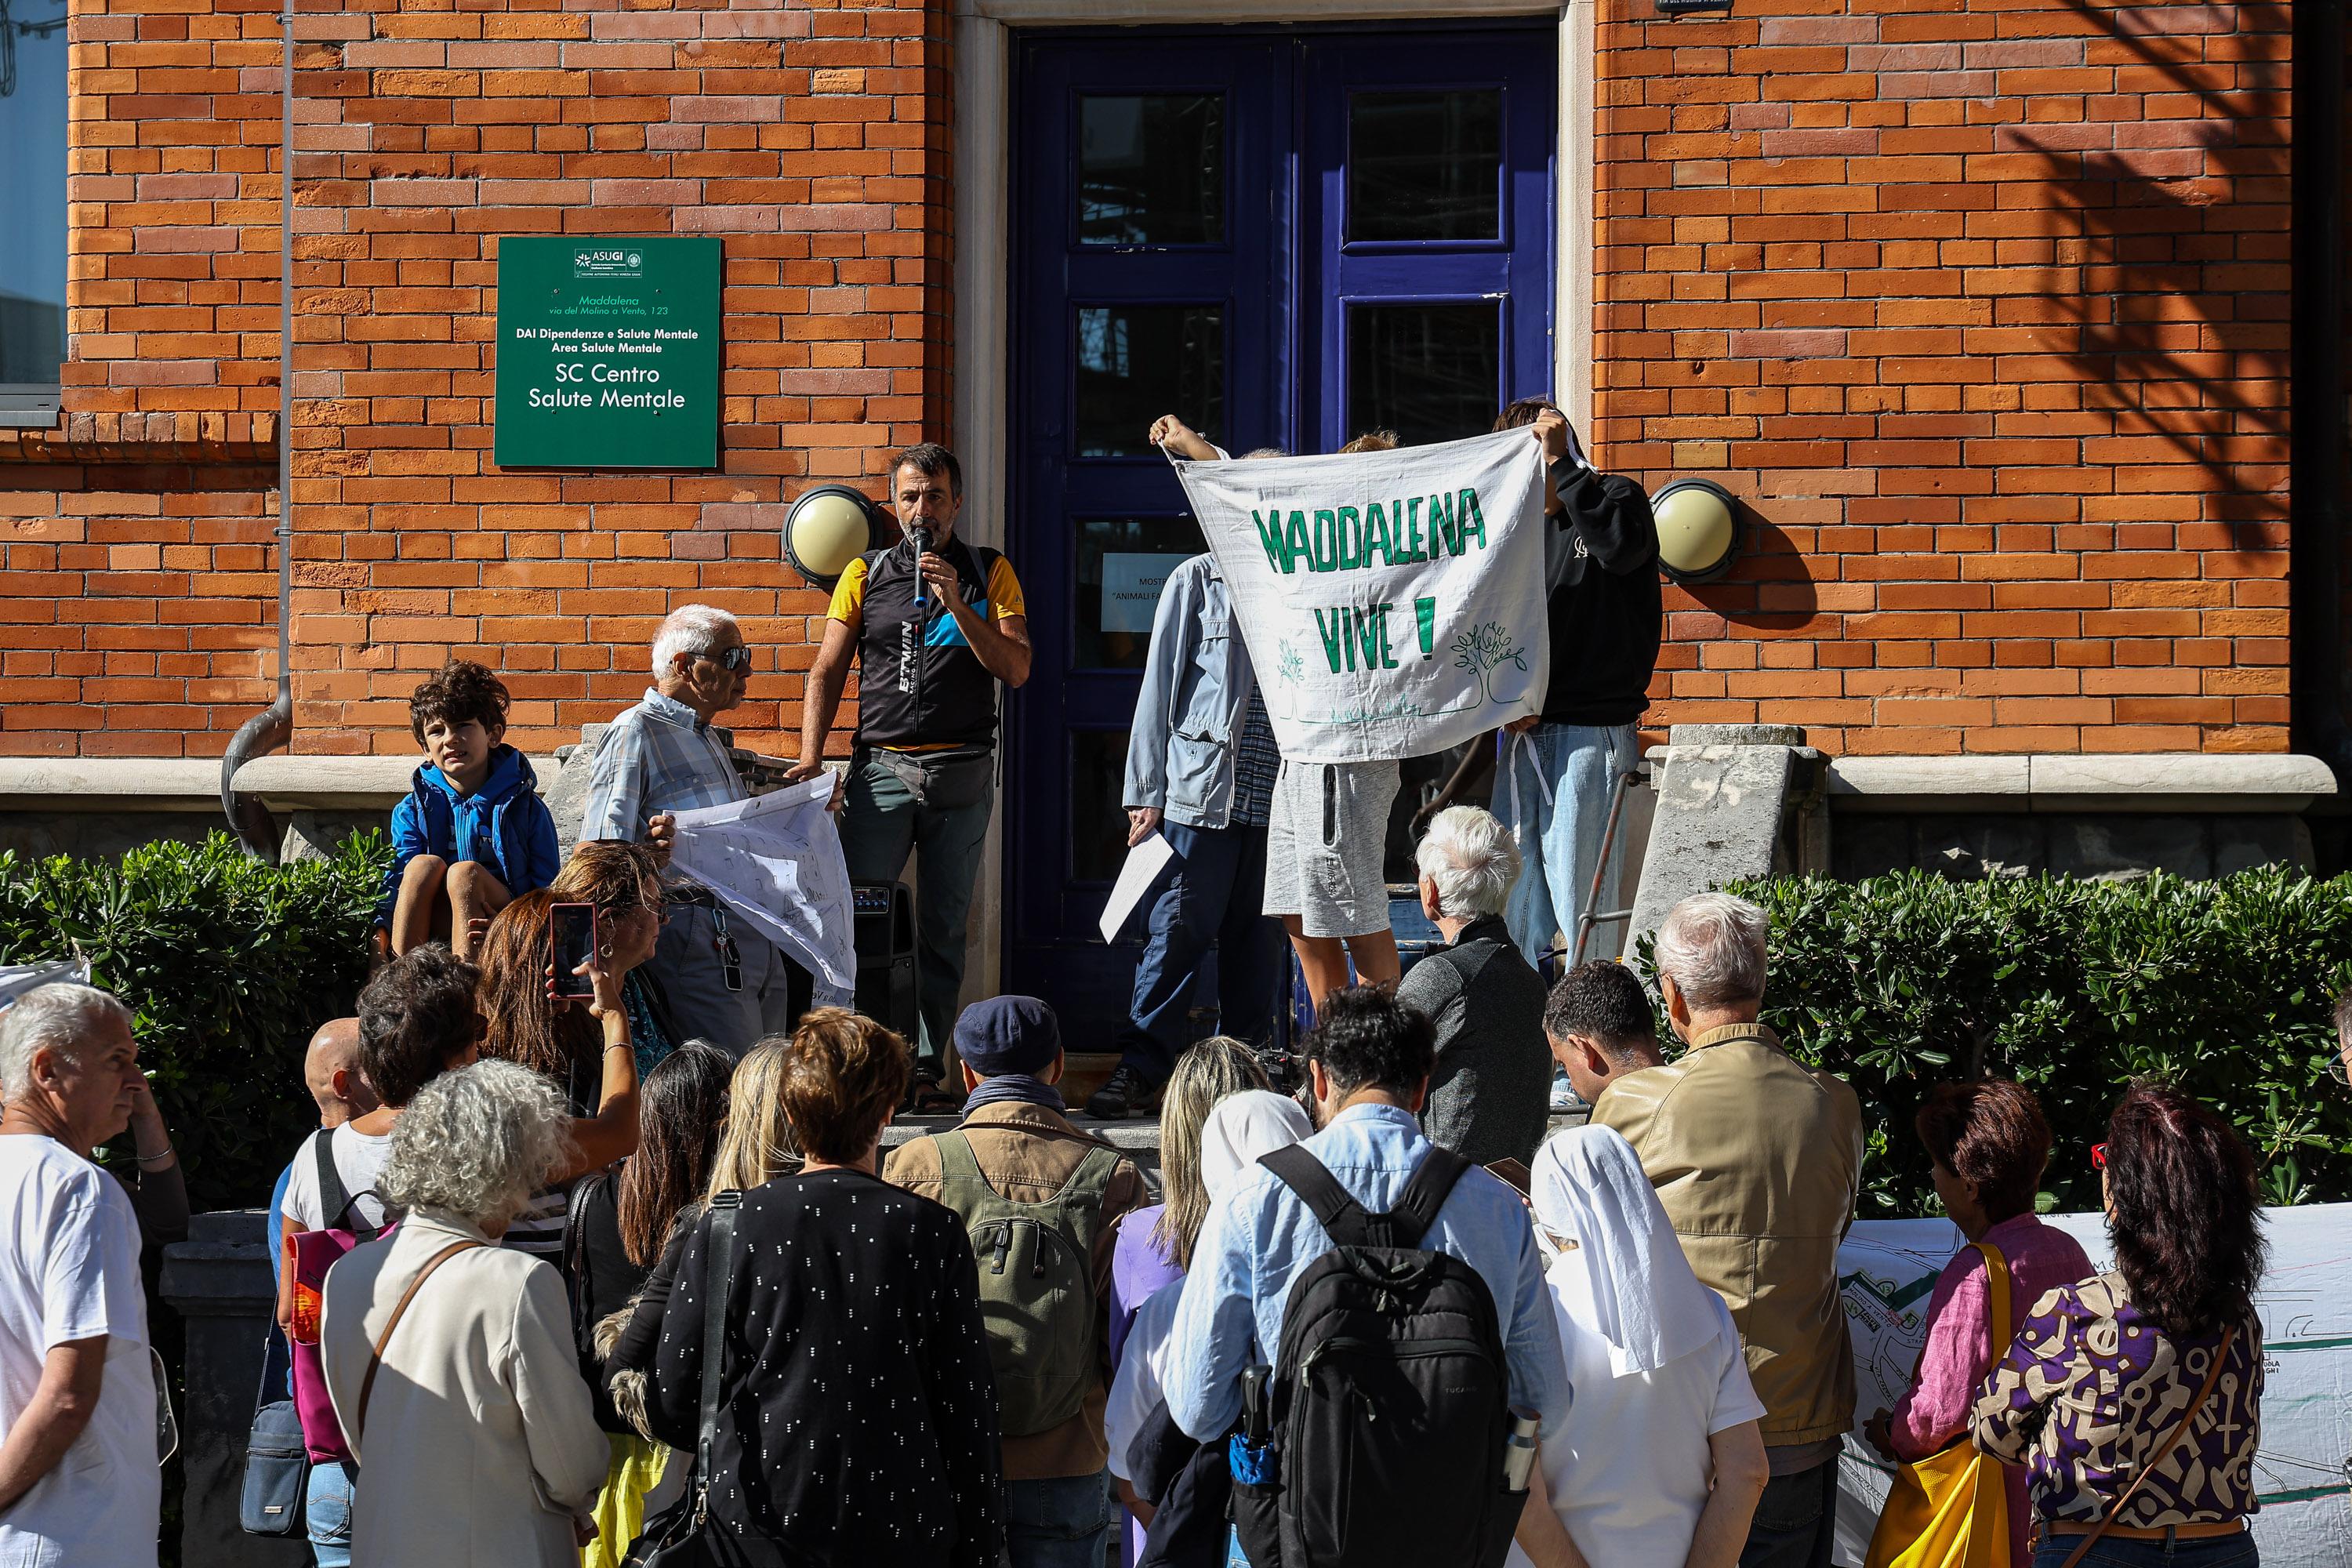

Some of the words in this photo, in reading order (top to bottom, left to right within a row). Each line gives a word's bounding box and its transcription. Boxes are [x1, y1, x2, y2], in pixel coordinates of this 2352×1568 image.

[592, 251, 623, 261] ASUGI
[579, 296, 639, 305] Maddalena
[621, 307, 647, 316] Vento,
[651, 307, 668, 315] 123
[516, 328, 536, 339] DAI
[539, 328, 604, 340] Dipendenze
[617, 328, 651, 339] Salute
[654, 328, 699, 339] Mentale
[551, 343, 578, 353] Area
[581, 343, 615, 353] Salute
[618, 343, 662, 353] Mentale
[555, 363, 584, 383] SC
[591, 363, 660, 383] Centro
[528, 388, 593, 407] Salute
[600, 389, 685, 408] Mentale
[1251, 488, 1486, 575] MADDALENA
[1314, 602, 1399, 673] VIVE
[1848, 1287, 1867, 1305] MOLINO
